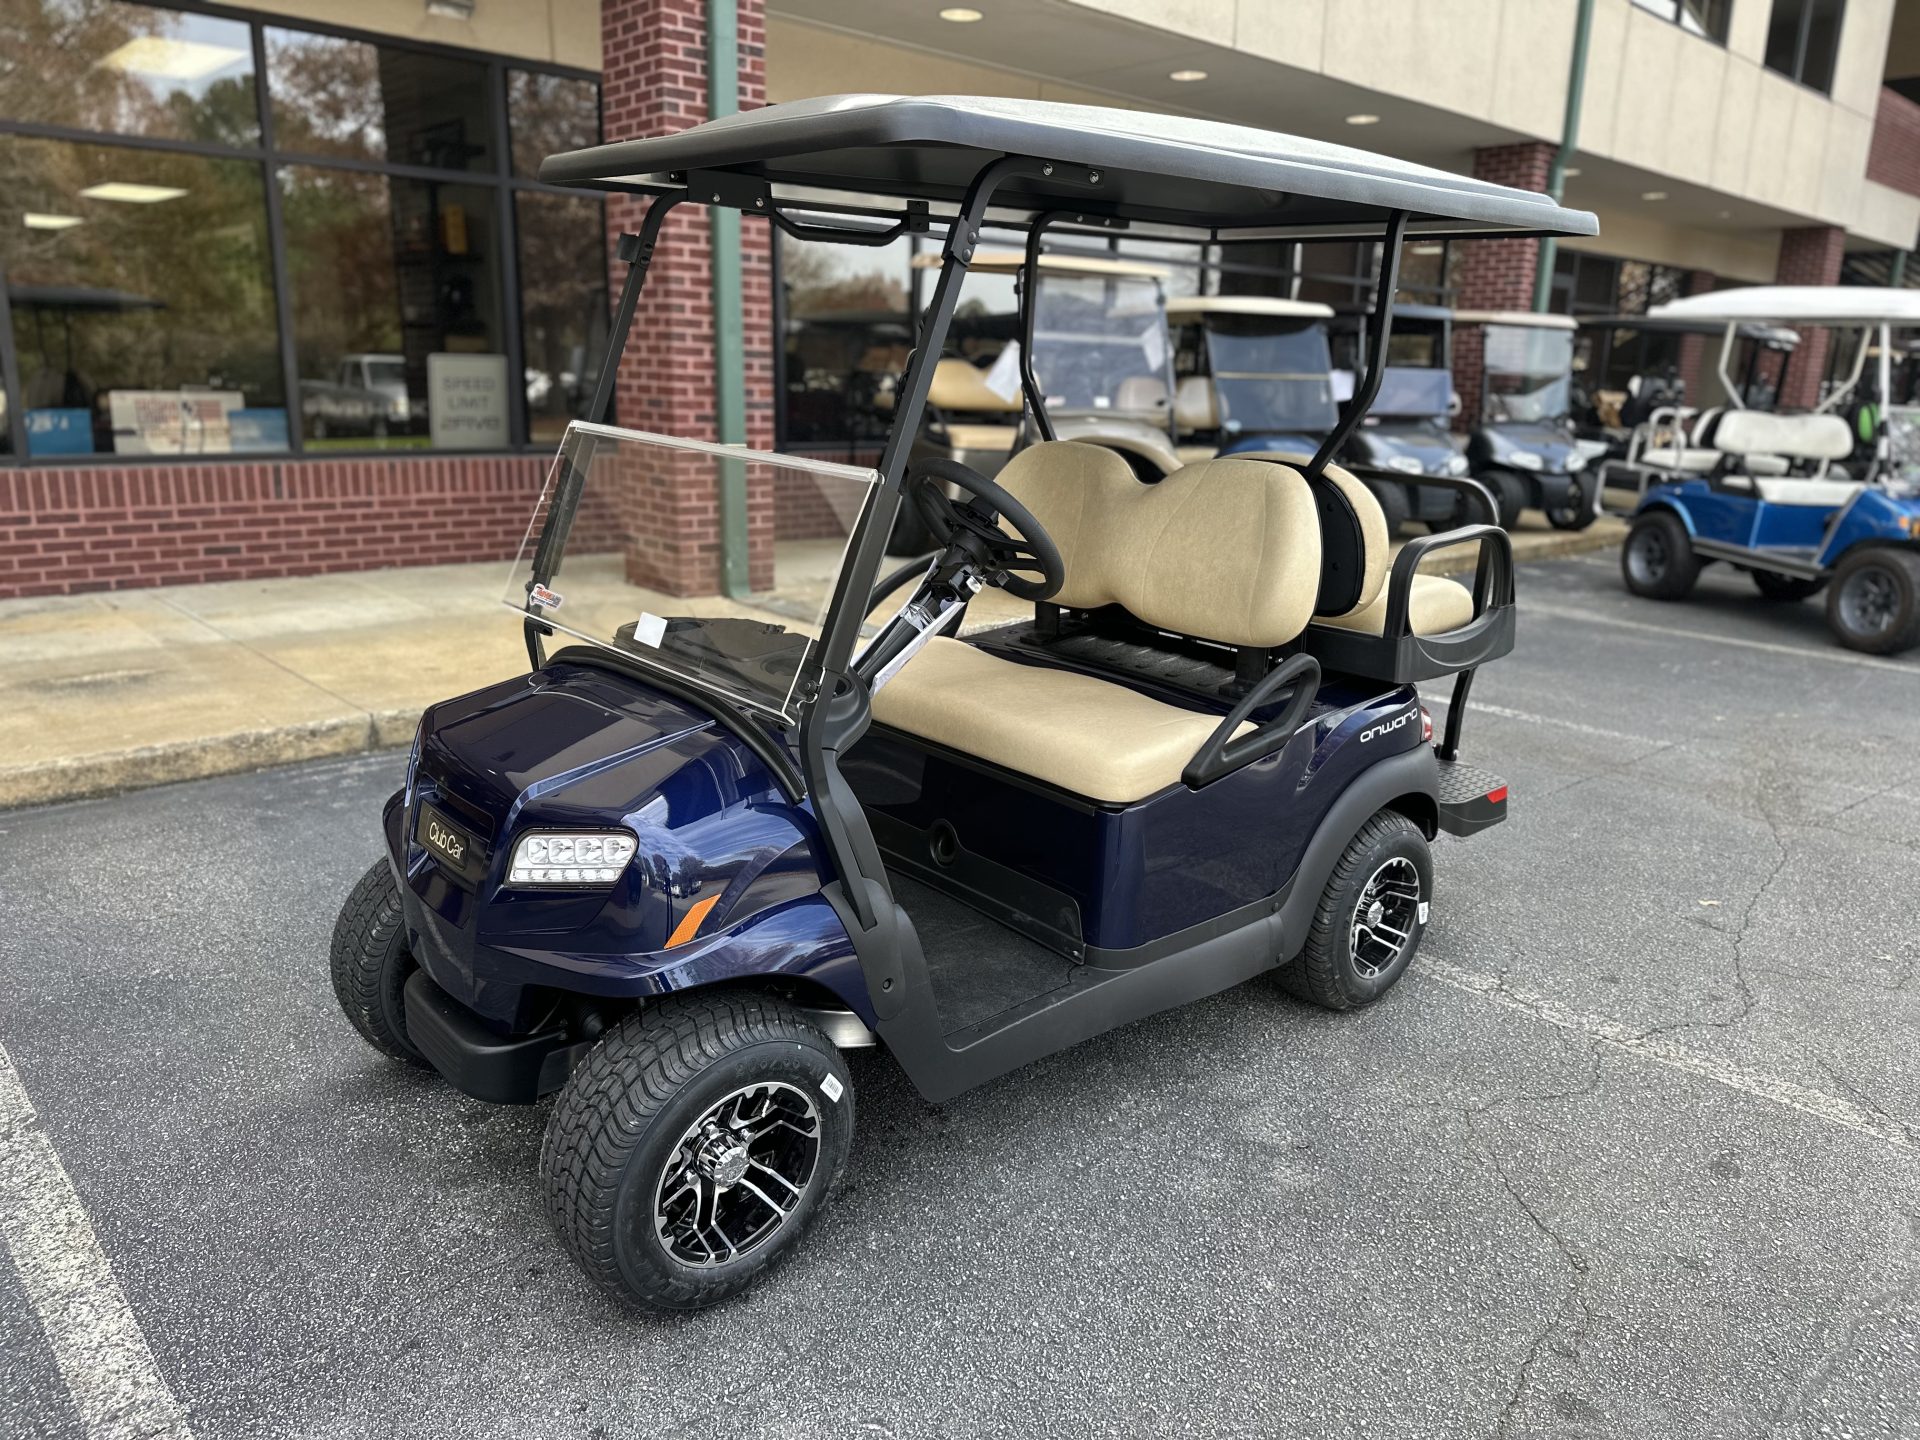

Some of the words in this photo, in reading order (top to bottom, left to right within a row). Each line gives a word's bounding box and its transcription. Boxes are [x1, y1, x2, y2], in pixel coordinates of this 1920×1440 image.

[1360, 708, 1418, 743] onward
[430, 821, 447, 849] Club
[447, 835, 464, 860] Car
